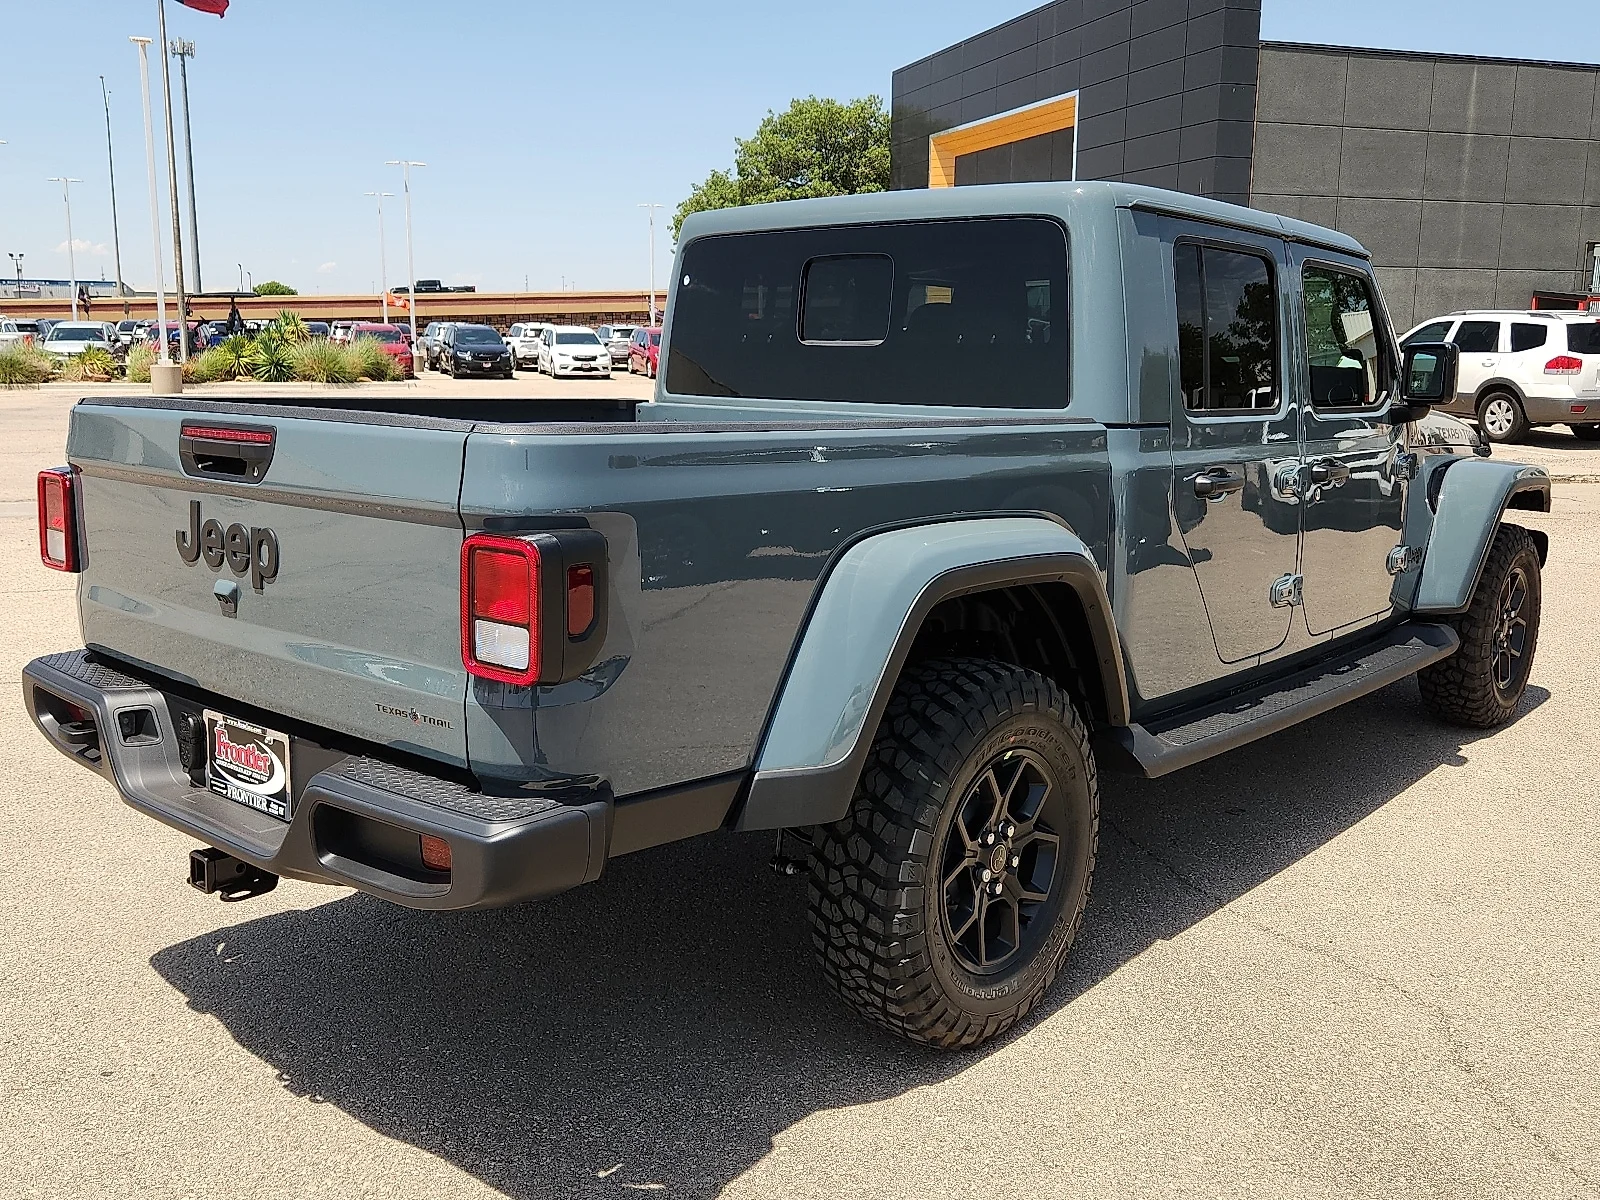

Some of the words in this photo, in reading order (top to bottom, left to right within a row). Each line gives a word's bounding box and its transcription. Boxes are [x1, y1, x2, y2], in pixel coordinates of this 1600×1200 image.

[176, 500, 280, 590] Jeep
[374, 703, 408, 718] TEXAS
[420, 714, 454, 730] TRAIL
[214, 727, 271, 775] Frontier
[227, 784, 268, 812] FRONTIER
